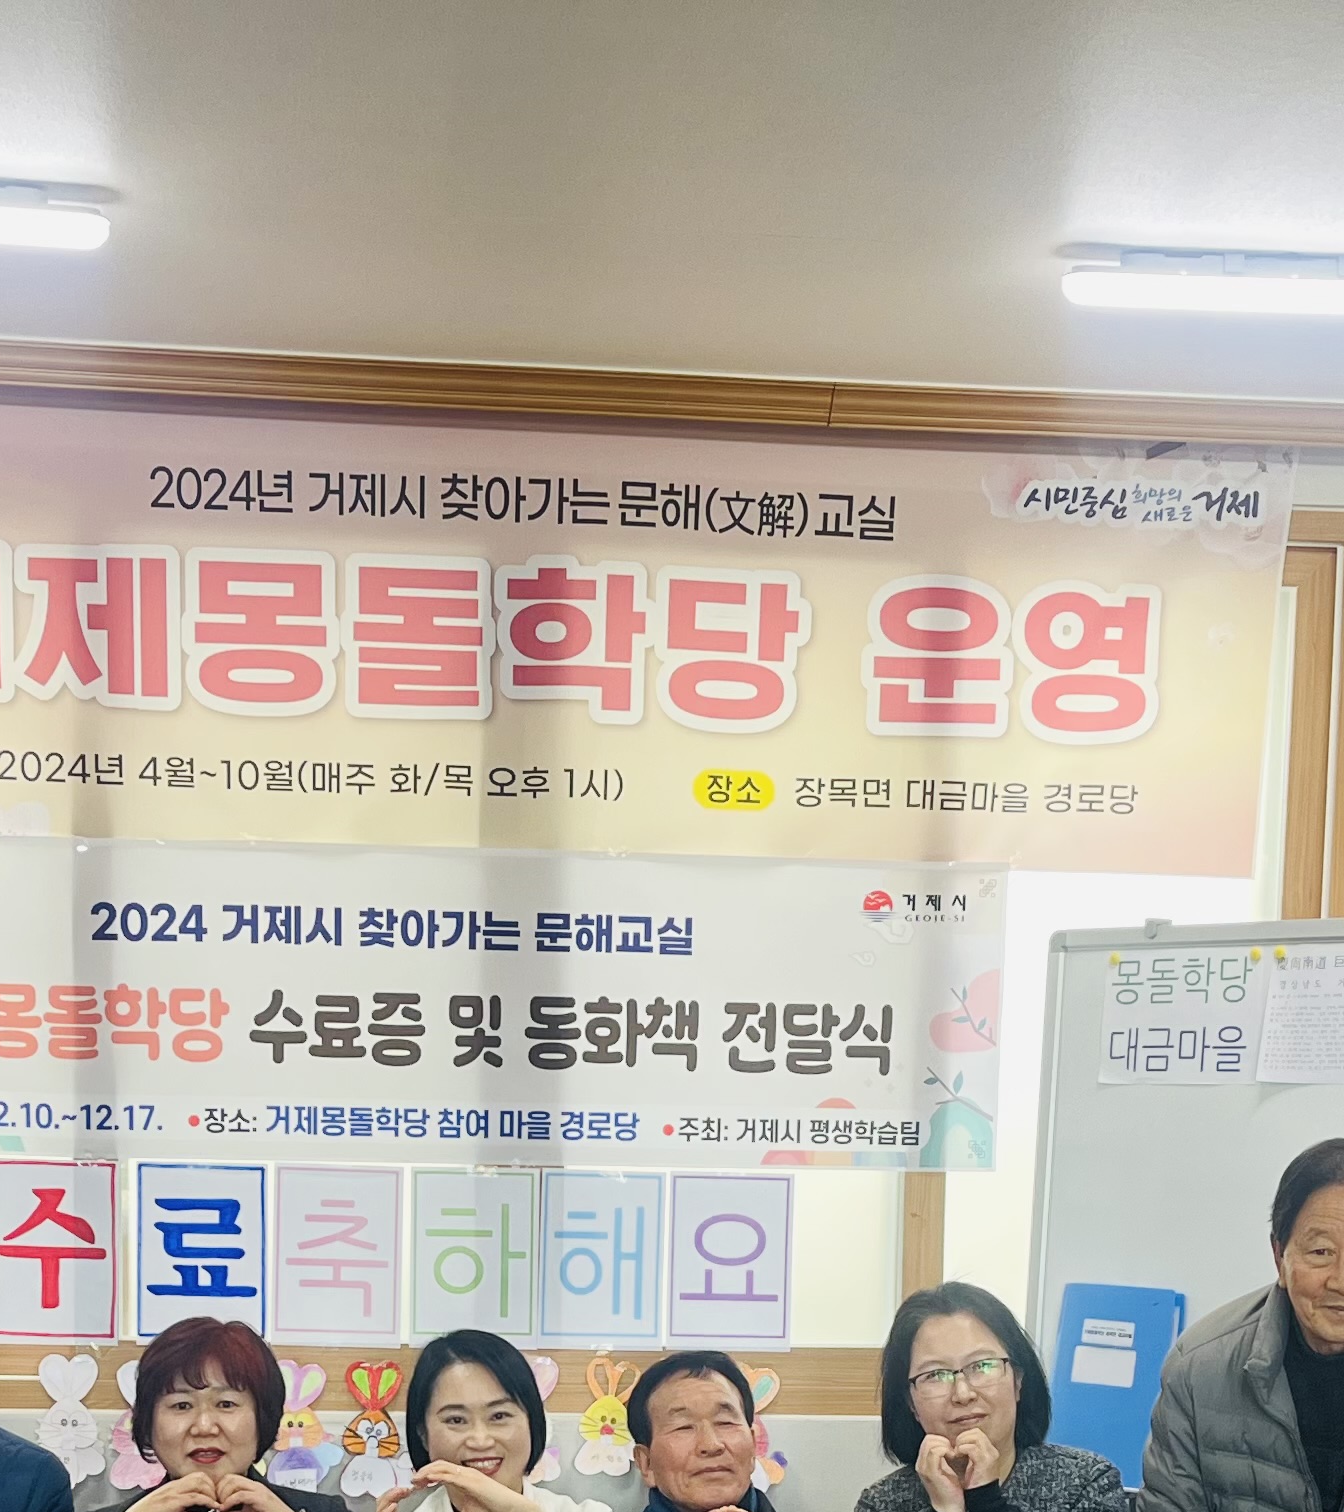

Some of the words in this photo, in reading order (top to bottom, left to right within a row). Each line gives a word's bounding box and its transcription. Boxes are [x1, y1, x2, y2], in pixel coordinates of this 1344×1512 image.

[150, 467, 294, 514] 2024년
[309, 473, 424, 519] 거제시
[441, 473, 609, 526] 찾아가는
[1023, 485, 1129, 520] 시민중심
[1141, 504, 1193, 525] 새로운
[1191, 488, 1260, 521] 거제
[873, 587, 1151, 732] 운영
[138, 753, 376, 796] 4월~10월(매주
[389, 759, 474, 799] 화/목
[487, 766, 551, 801] 오후
[564, 767, 624, 803] 1시)
[706, 773, 761, 805] 장소
[795, 775, 892, 810] 장목면
[906, 778, 1030, 814] 대금마을
[1043, 781, 1138, 815] 경로당
[90, 902, 208, 943] 2024
[221, 904, 344, 947] 거제시
[358, 907, 520, 952] 찾아가는
[535, 911, 693, 956] 문해교실
[905, 913, 966, 923] GEOJE-SI
[1111, 955, 1253, 1006] 몽돌학당
[249, 988, 426, 1067] 수료증
[448, 994, 503, 1068] 및
[524, 995, 700, 1072] 동화책
[722, 1001, 894, 1076] 전달식
[1109, 1024, 1247, 1073] 대금마을
[204, 1108, 258, 1135] 장소:
[266, 1106, 430, 1138] 거제몽돌학당
[437, 1110, 490, 1140] 참여
[499, 1111, 551, 1140] 마을
[560, 1112, 640, 1142] 경로당
[678, 1116, 729, 1144] 주최:
[736, 1117, 802, 1145] 거제시
[809, 1119, 921, 1147] 평생학습팀
